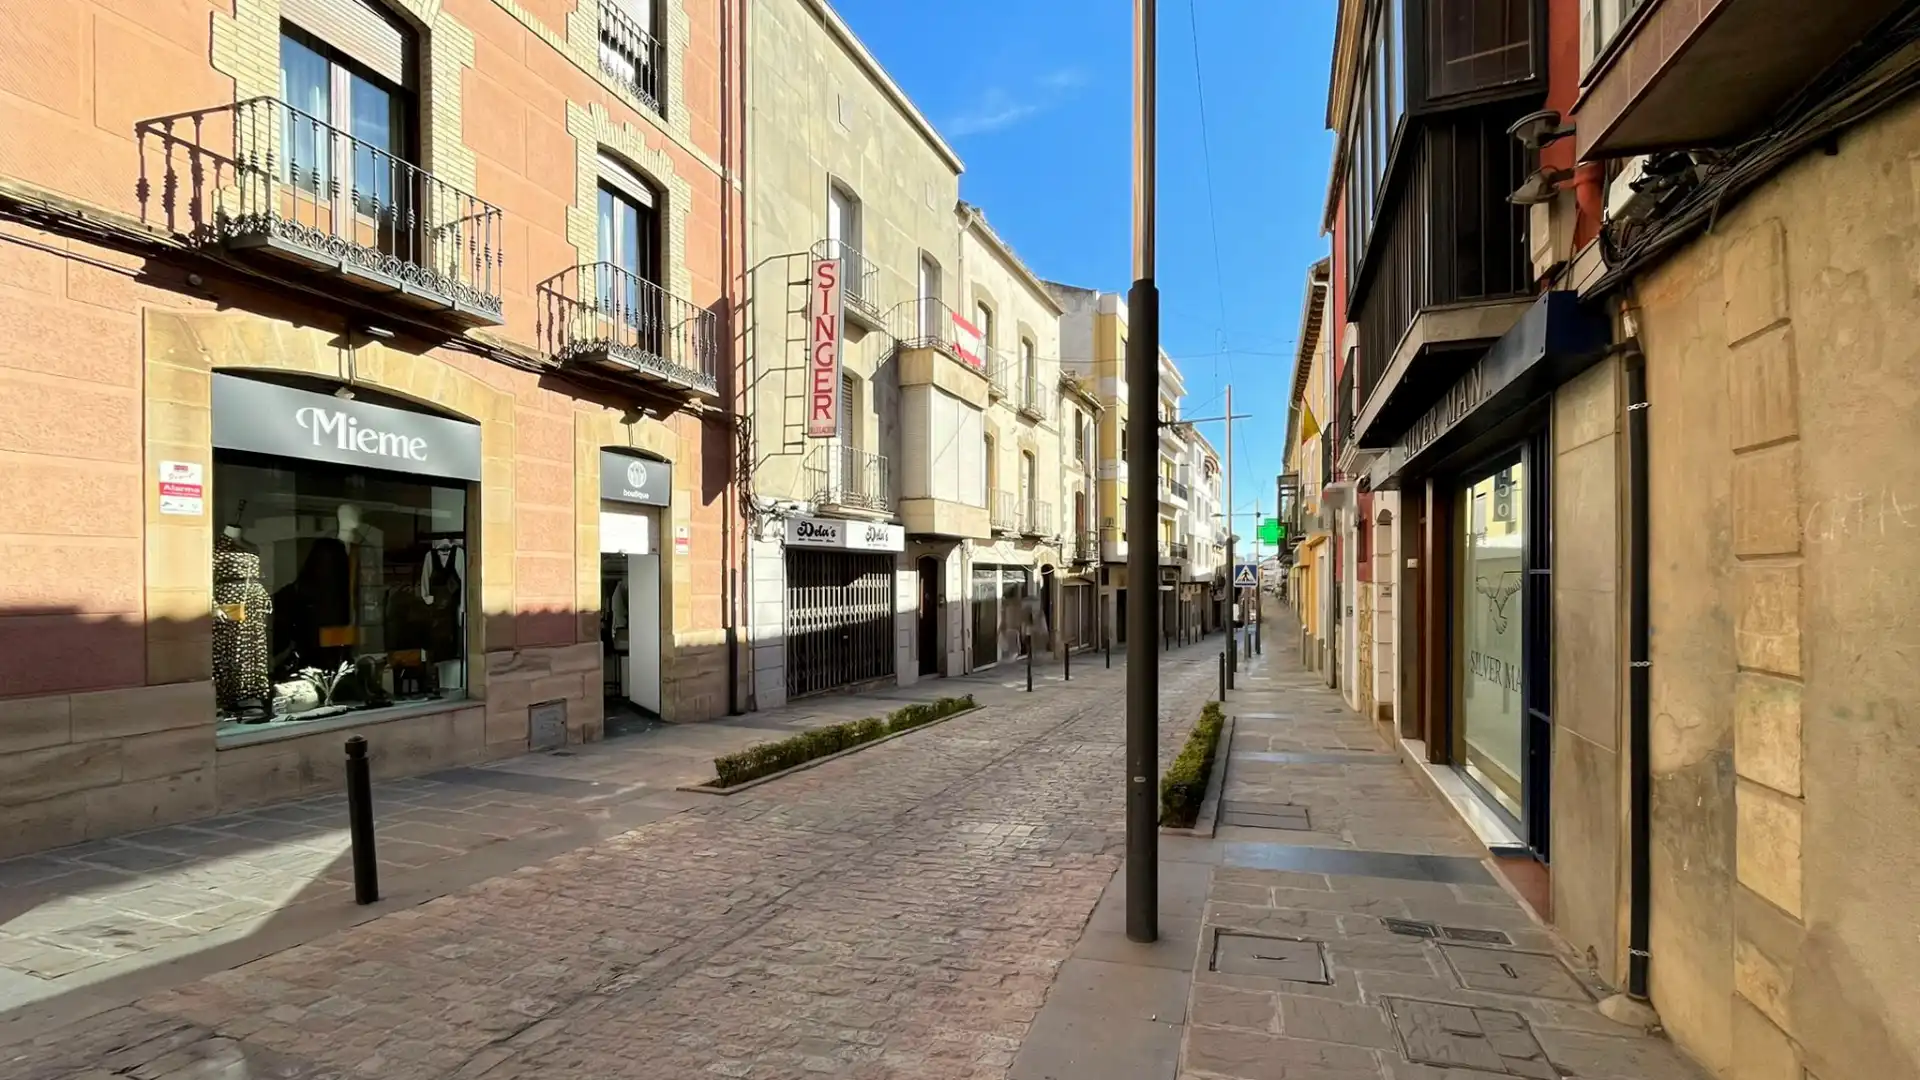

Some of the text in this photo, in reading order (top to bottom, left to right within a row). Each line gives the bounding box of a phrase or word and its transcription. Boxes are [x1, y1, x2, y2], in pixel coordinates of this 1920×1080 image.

[812, 263, 835, 420] SINGER
[295, 407, 428, 461] Mieme
[1403, 360, 1484, 460] SILVER MAN
[623, 489, 650, 500] boutique
[796, 520, 837, 538] Dela's
[1470, 650, 1524, 695] SILVER MA
